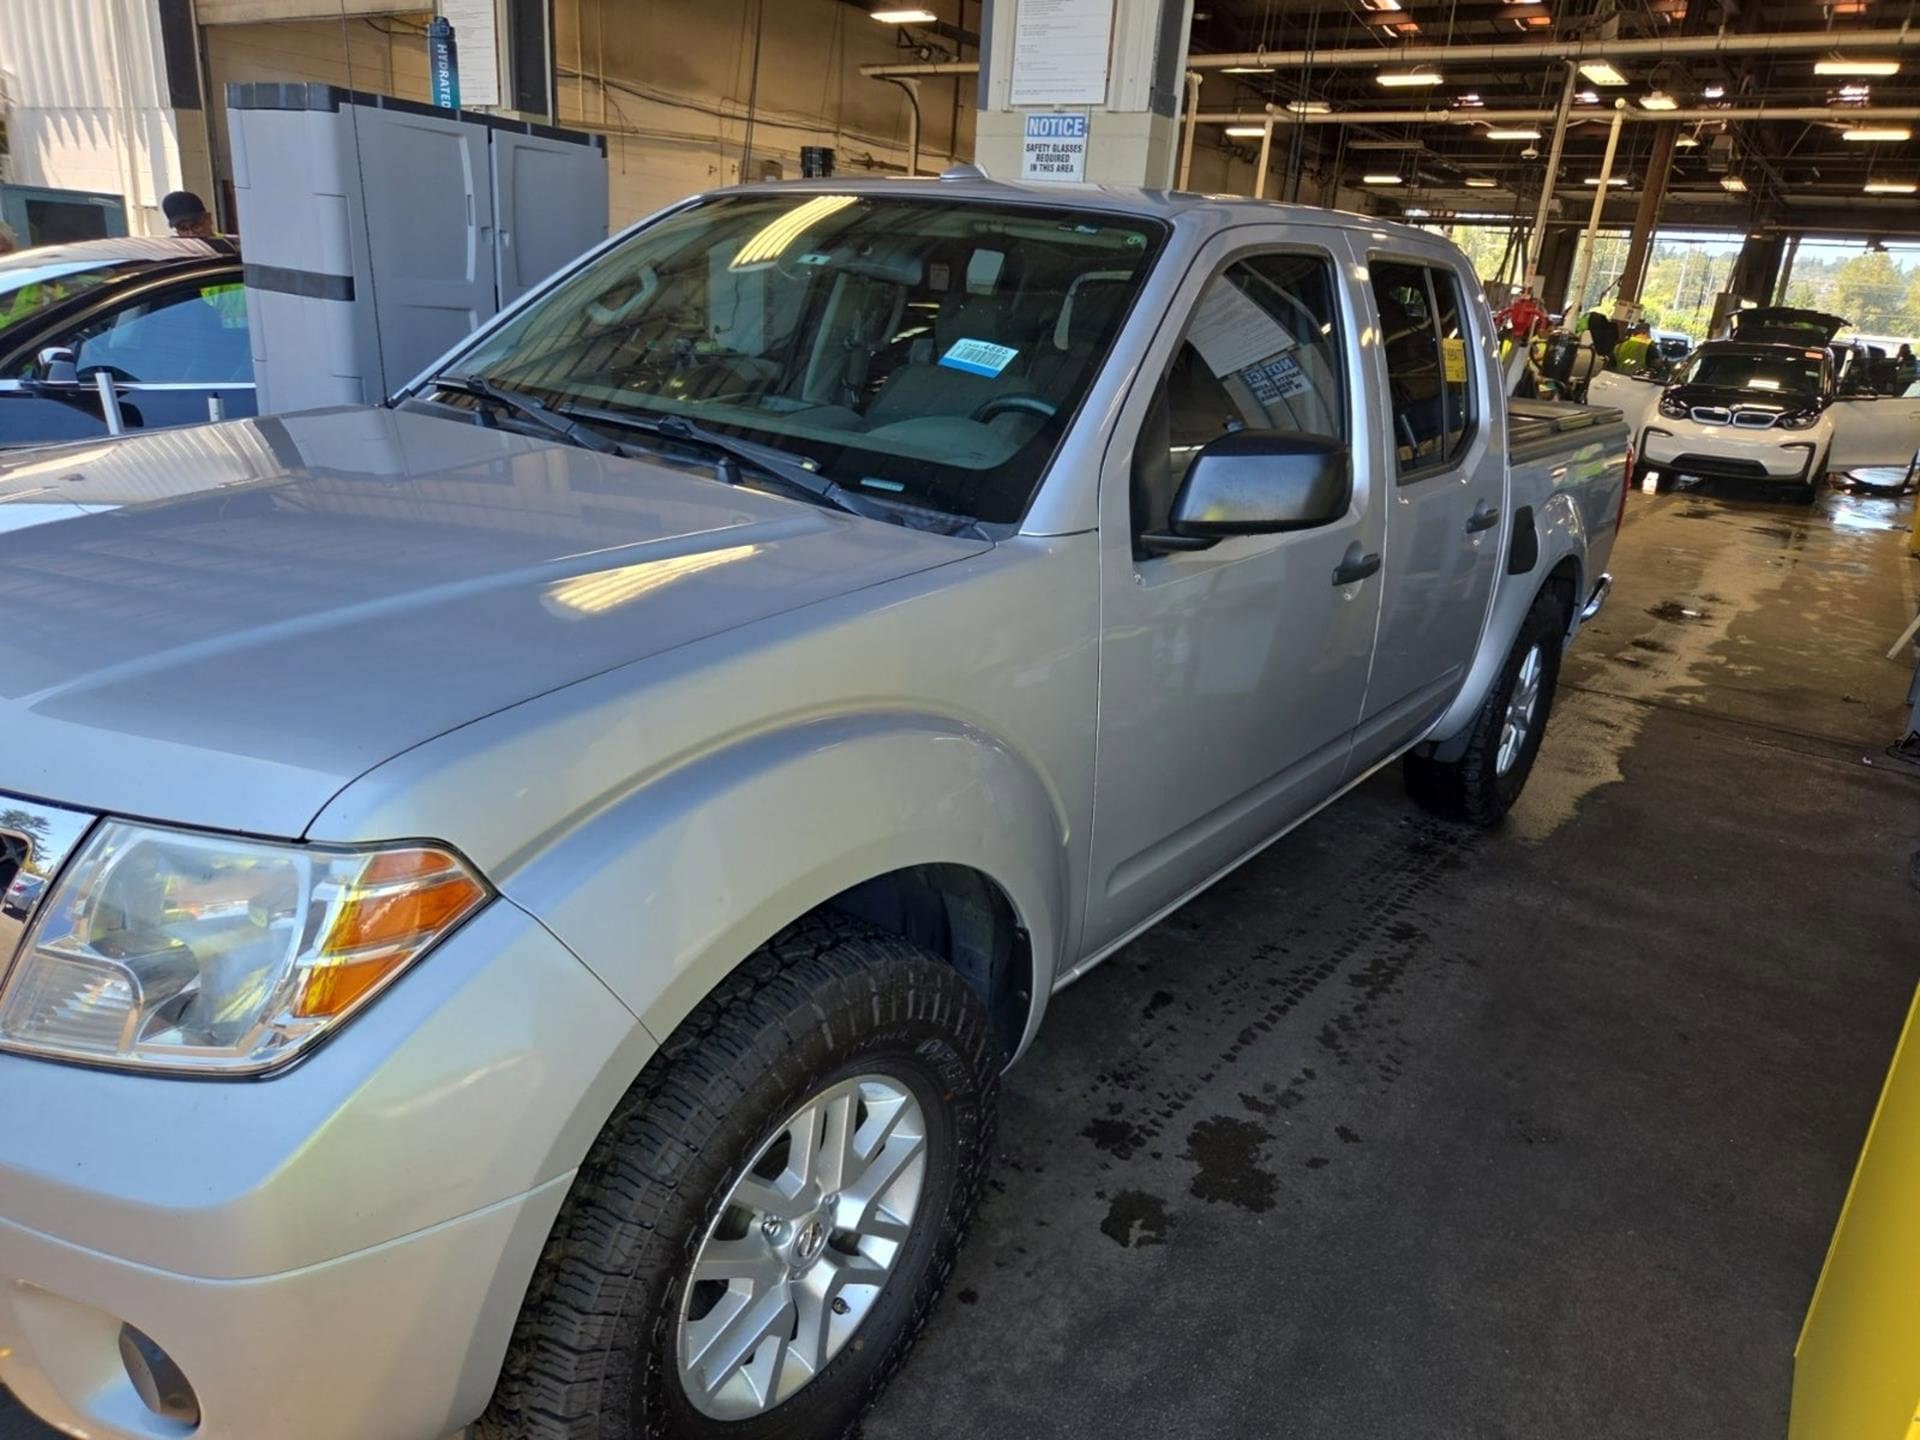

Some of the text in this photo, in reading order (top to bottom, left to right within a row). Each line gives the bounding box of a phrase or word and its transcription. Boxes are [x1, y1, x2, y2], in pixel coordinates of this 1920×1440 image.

[437, 43, 452, 109] HYDRATED
[1028, 117, 1084, 136] NOTICE
[1026, 143, 1082, 153] SAFETY GLASSES
[1036, 153, 1070, 163] REQUIRED
[1030, 163, 1074, 173] IN THIS AREA
